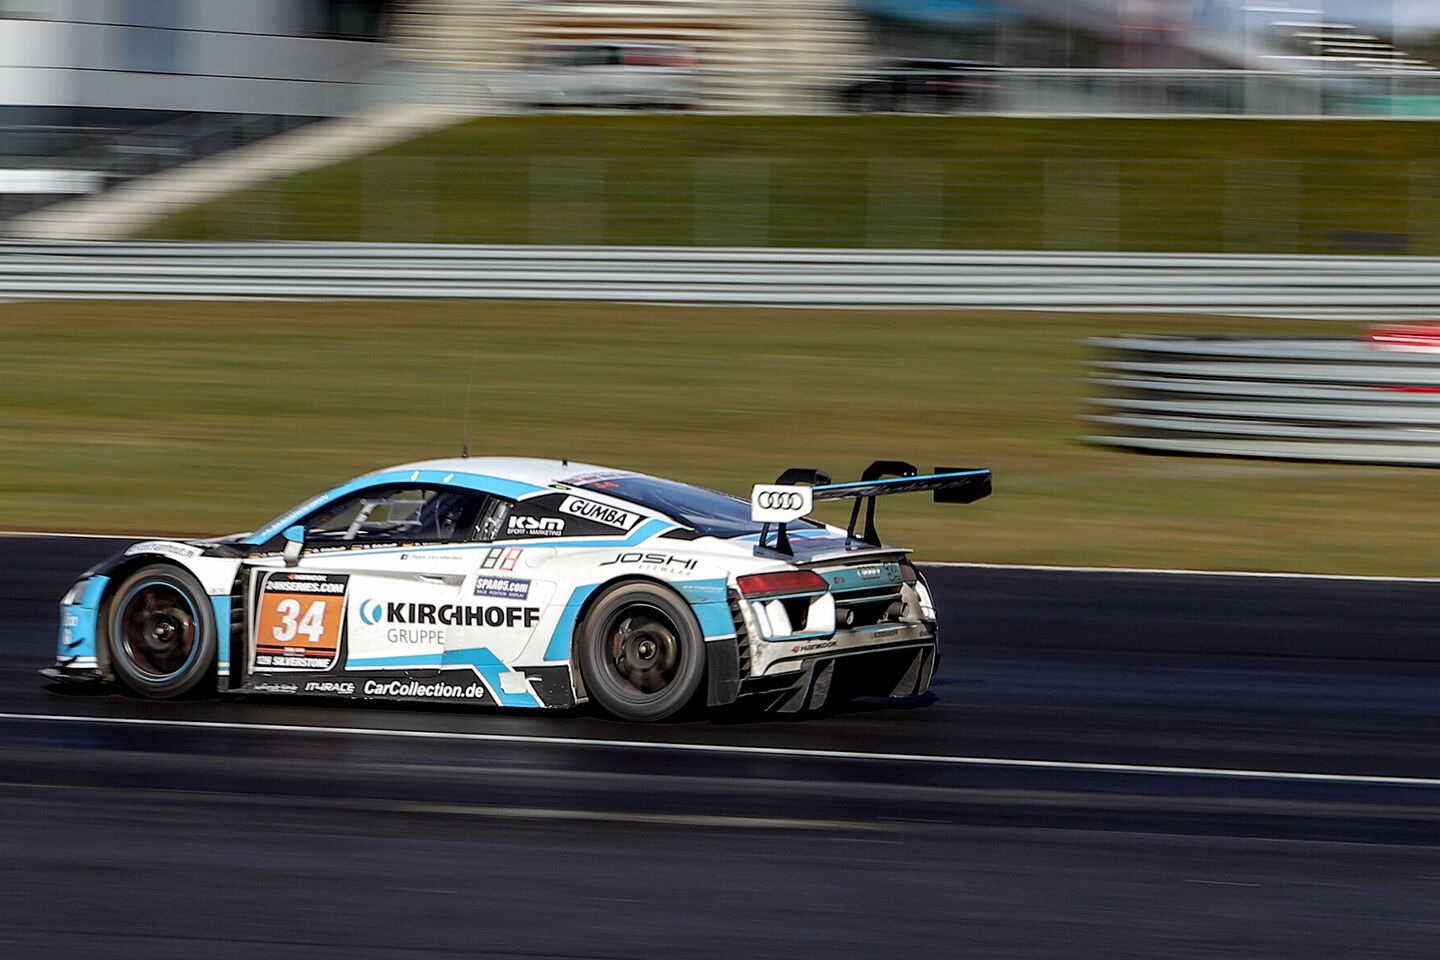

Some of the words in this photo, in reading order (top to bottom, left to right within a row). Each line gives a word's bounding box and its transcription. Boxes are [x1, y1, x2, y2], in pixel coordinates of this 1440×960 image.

[569, 500, 628, 527] GUMBA
[599, 552, 699, 570] JOSHI
[476, 578, 529, 594] SPAA05.com
[272, 599, 327, 642] 34
[386, 602, 540, 628] KIRCHHOFF
[387, 628, 445, 645] GRUPPE
[271, 656, 332, 669] SILVERSTONE
[364, 680, 484, 698] CarCollection.de
